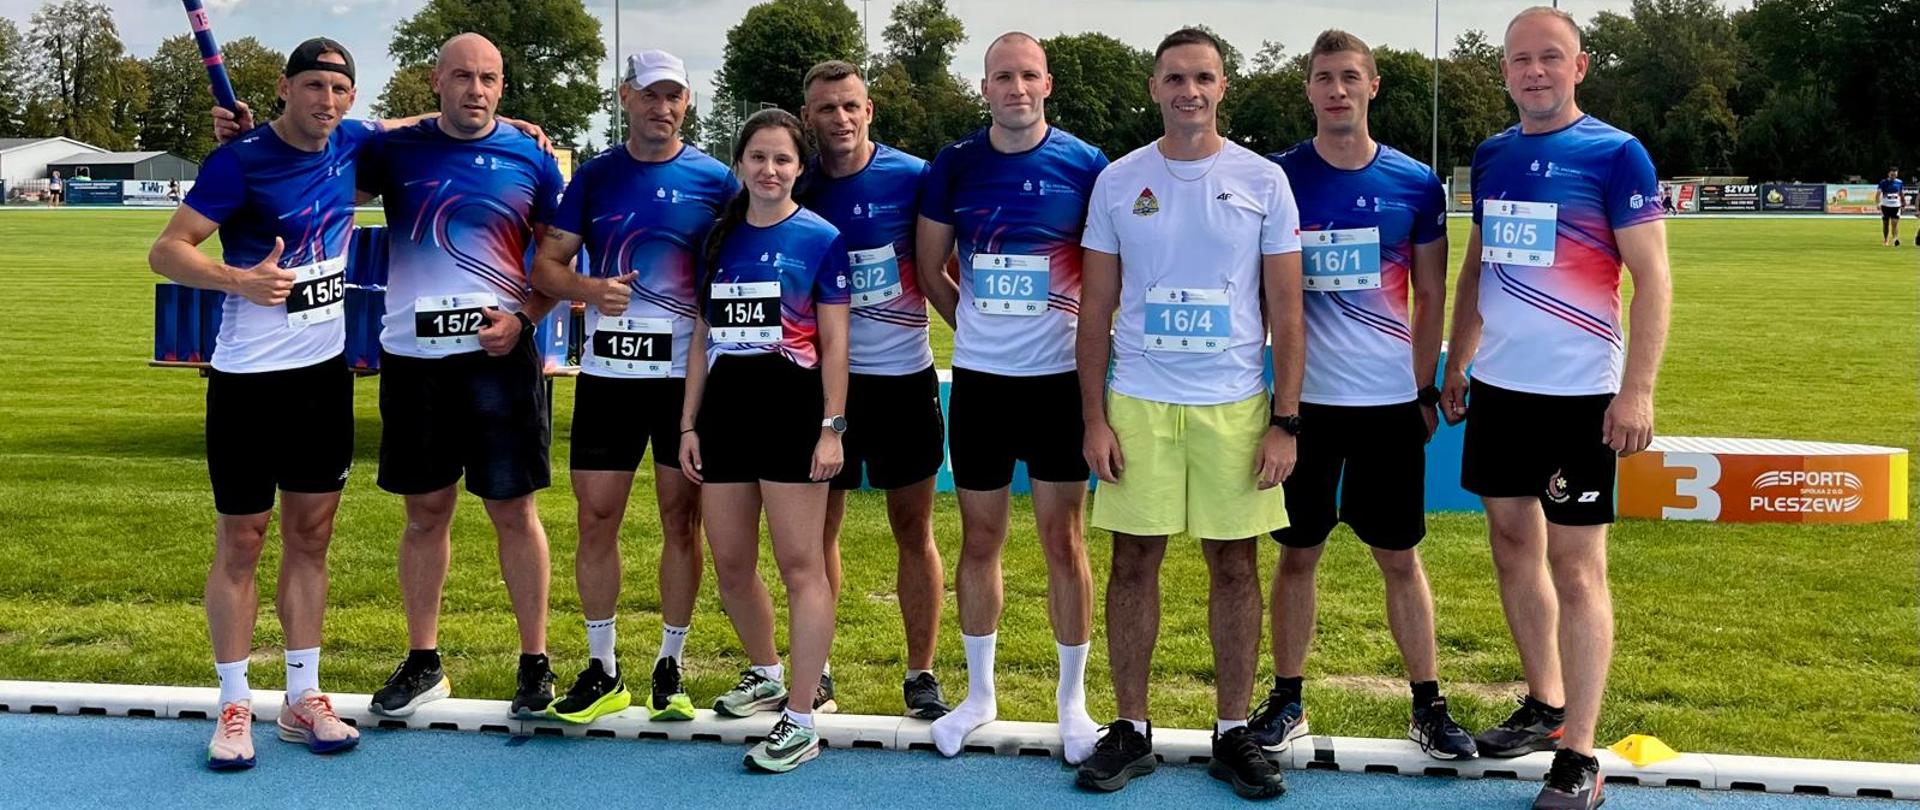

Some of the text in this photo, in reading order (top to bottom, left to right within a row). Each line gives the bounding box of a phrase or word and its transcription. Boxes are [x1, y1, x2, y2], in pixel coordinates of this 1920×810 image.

[1724, 185, 1758, 193] SZYBY
[1492, 221, 1537, 245] 16/5
[1310, 248, 1361, 272] 16/1
[852, 267, 887, 290] 6/2
[985, 274, 1033, 296] 16/3
[302, 277, 343, 305] 15/5
[433, 311, 483, 334] 15/2
[724, 302, 766, 323] 15/4
[1160, 309, 1213, 332] 16/4
[607, 335, 653, 357] 15/1
[1661, 452, 1721, 520] 3
[1779, 471, 1844, 486] SPORT
[1750, 496, 1844, 512] PLESZEW
